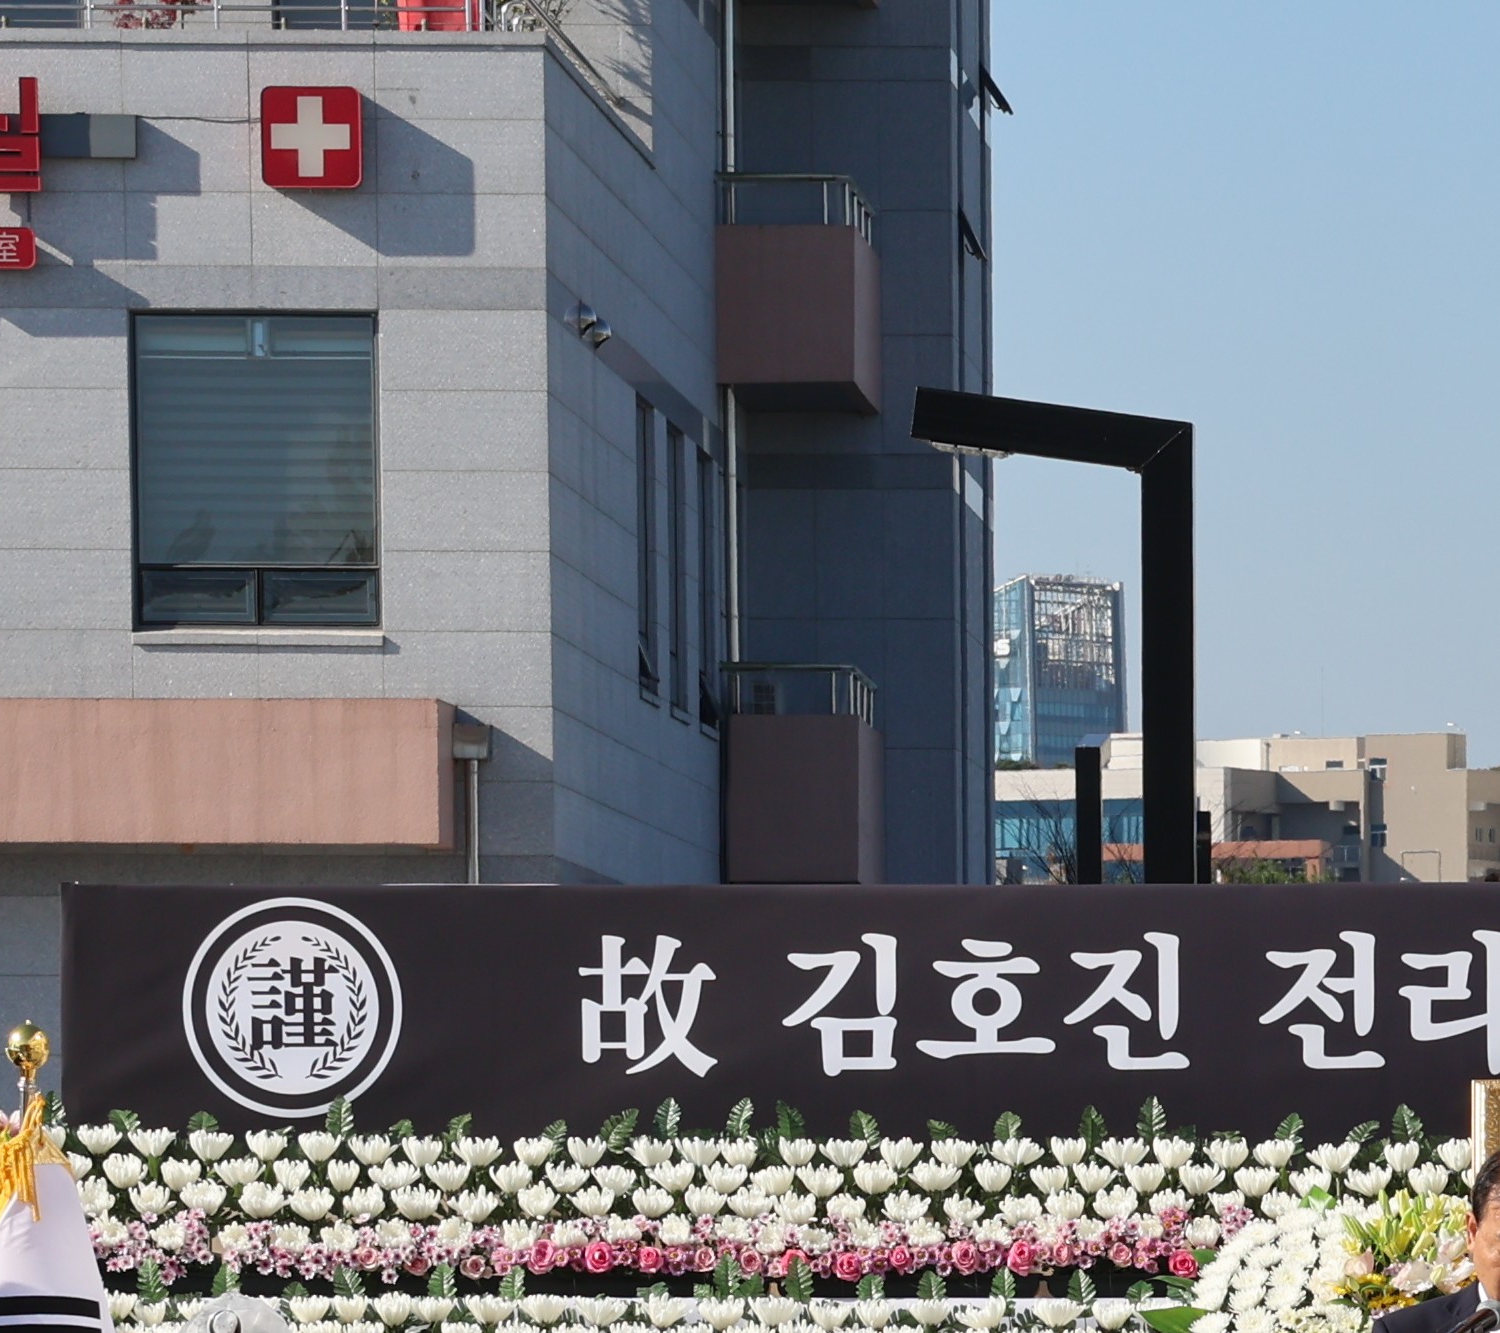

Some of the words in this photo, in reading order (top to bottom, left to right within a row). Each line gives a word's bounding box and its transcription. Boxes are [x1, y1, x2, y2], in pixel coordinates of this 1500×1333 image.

[247, 956, 340, 1051] 謹
[578, 934, 718, 1078] 故
[781, 931, 1191, 1077] 김호진
